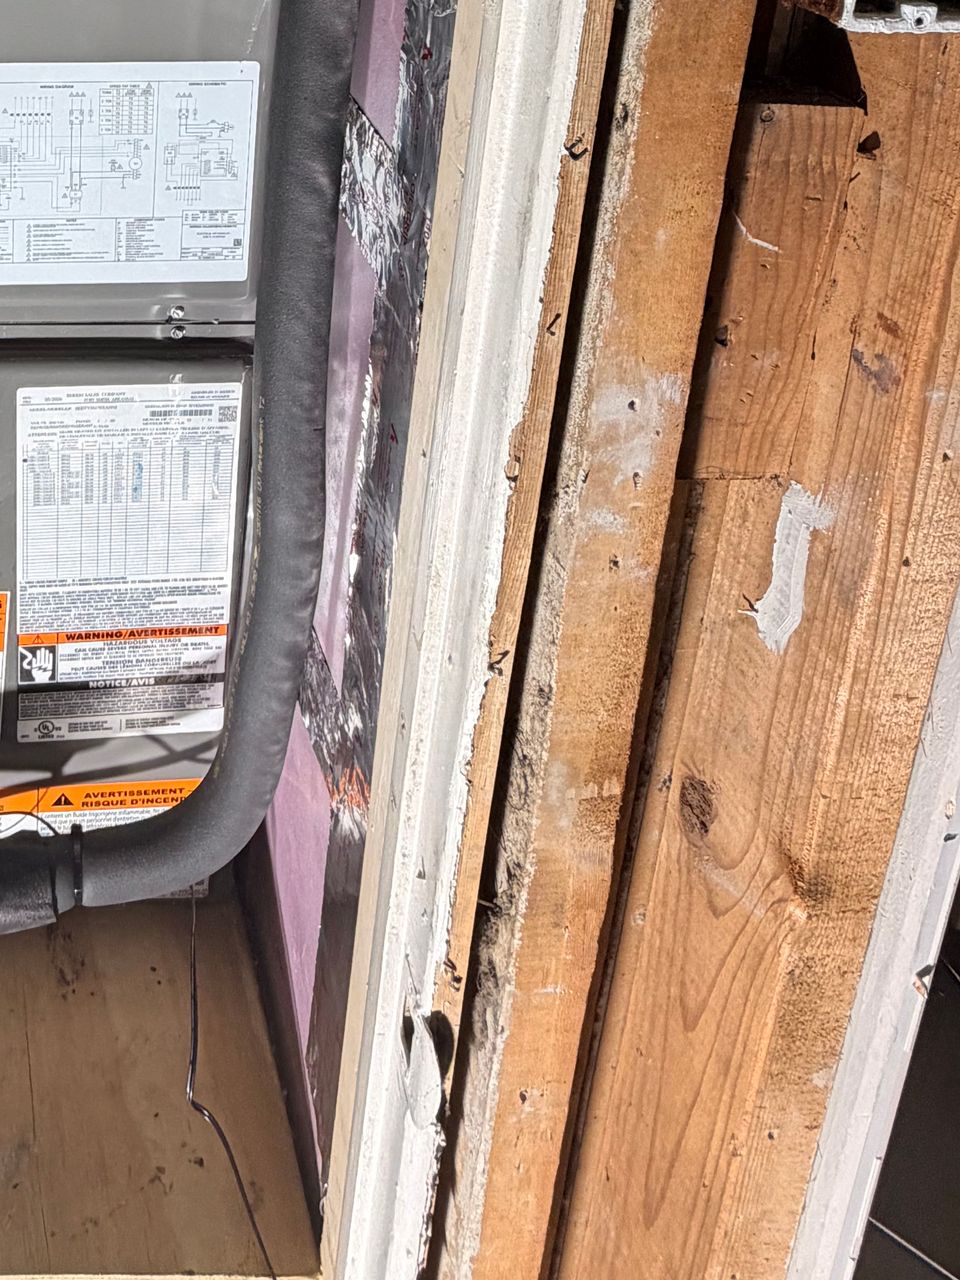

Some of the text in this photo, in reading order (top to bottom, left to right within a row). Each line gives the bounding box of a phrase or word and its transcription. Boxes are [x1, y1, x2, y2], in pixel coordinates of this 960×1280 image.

[65, 626, 220, 641] WARNING/AVERTISSEMENT
[89, 677, 155, 688] NOTICE/AVIS
[84, 787, 186, 799] AVERTISSEMENT
[81, 799, 127, 807] RISQUE
